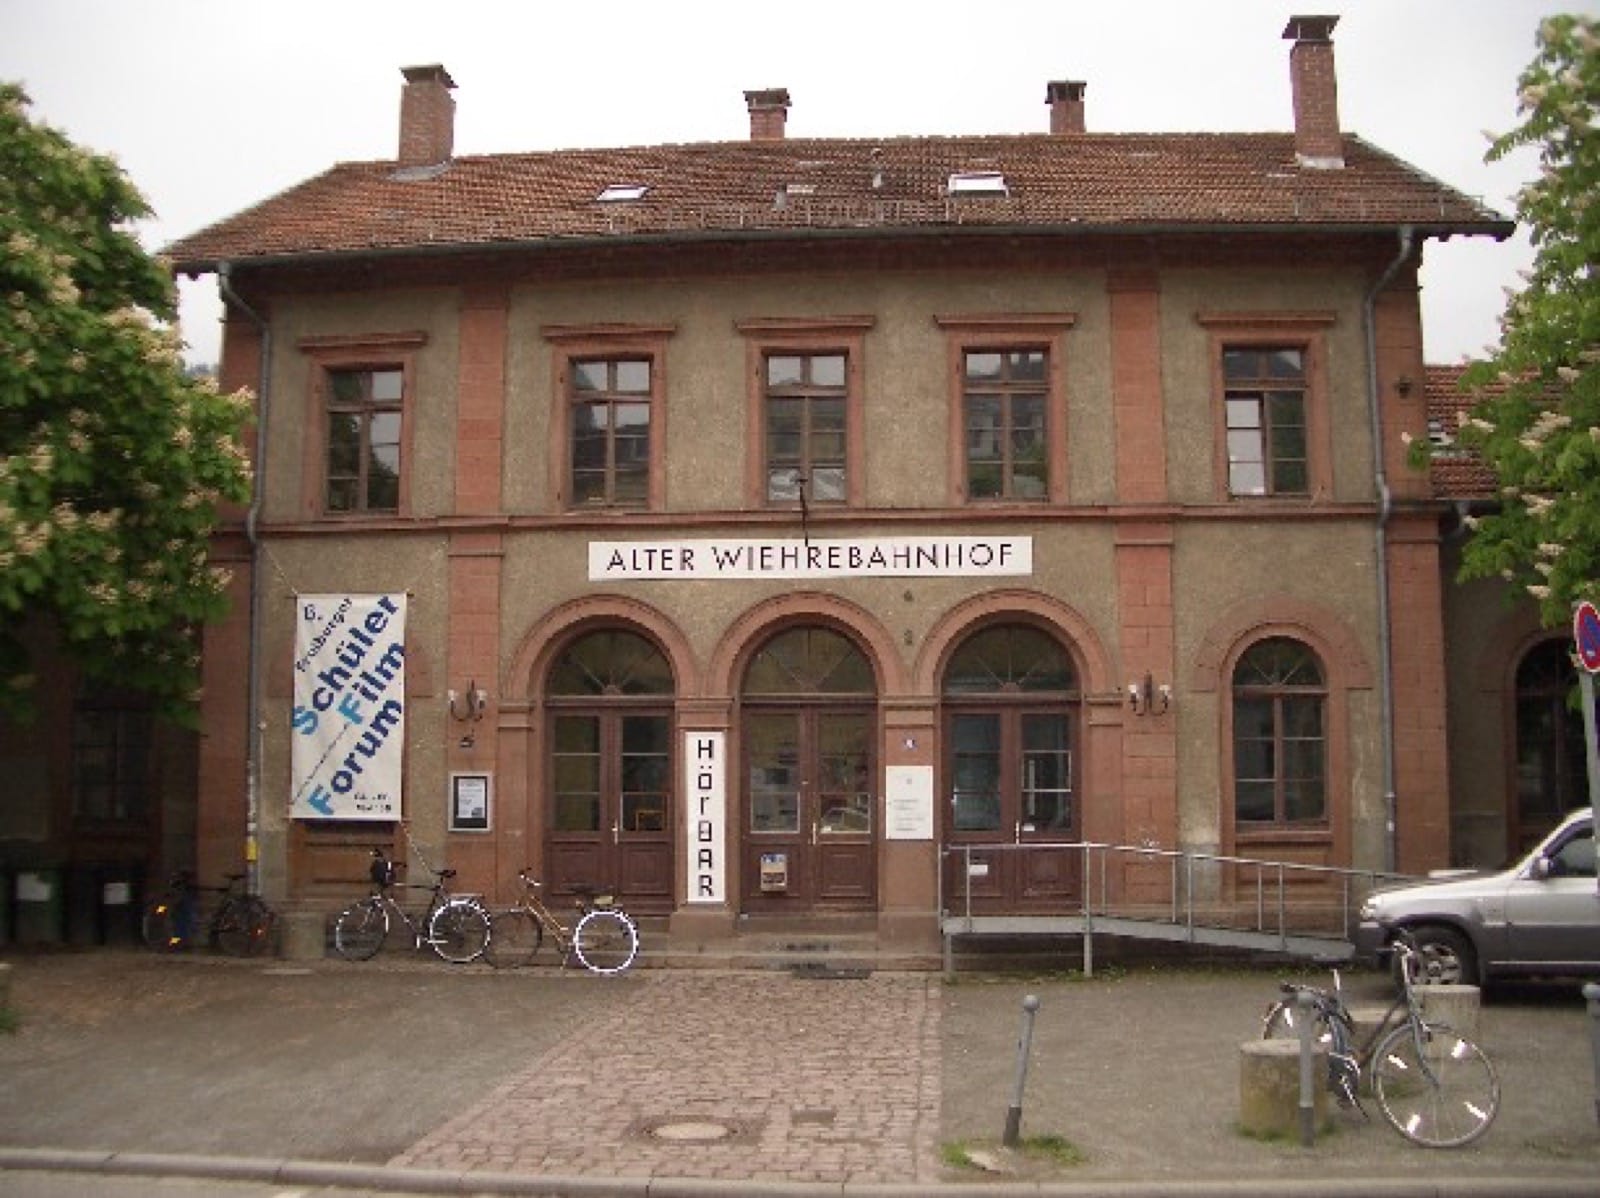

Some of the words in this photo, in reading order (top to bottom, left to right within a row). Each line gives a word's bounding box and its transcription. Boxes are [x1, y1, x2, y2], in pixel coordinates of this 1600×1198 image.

[606, 547, 695, 571] ALTER
[711, 543, 1013, 571] WIEHREBAHNHOF
[292, 595, 400, 735] Schüler
[336, 642, 405, 725] Film
[307, 699, 402, 816] Forum
